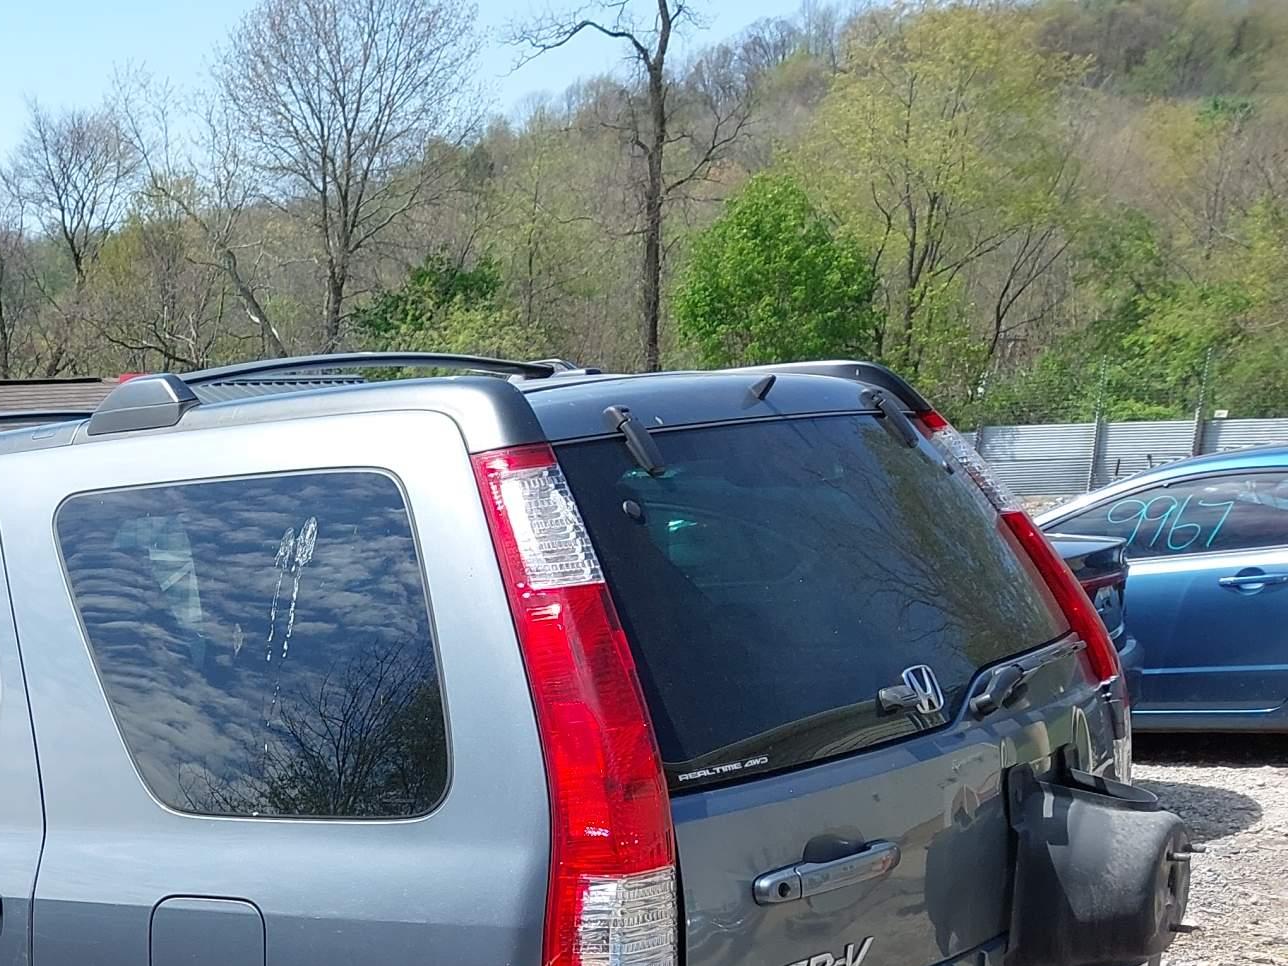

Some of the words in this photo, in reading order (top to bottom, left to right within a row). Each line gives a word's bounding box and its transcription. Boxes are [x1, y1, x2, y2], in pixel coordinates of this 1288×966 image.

[1107, 494, 1235, 550] 9967
[677, 762, 743, 782] REALTIME
[743, 756, 769, 769] 4WD
